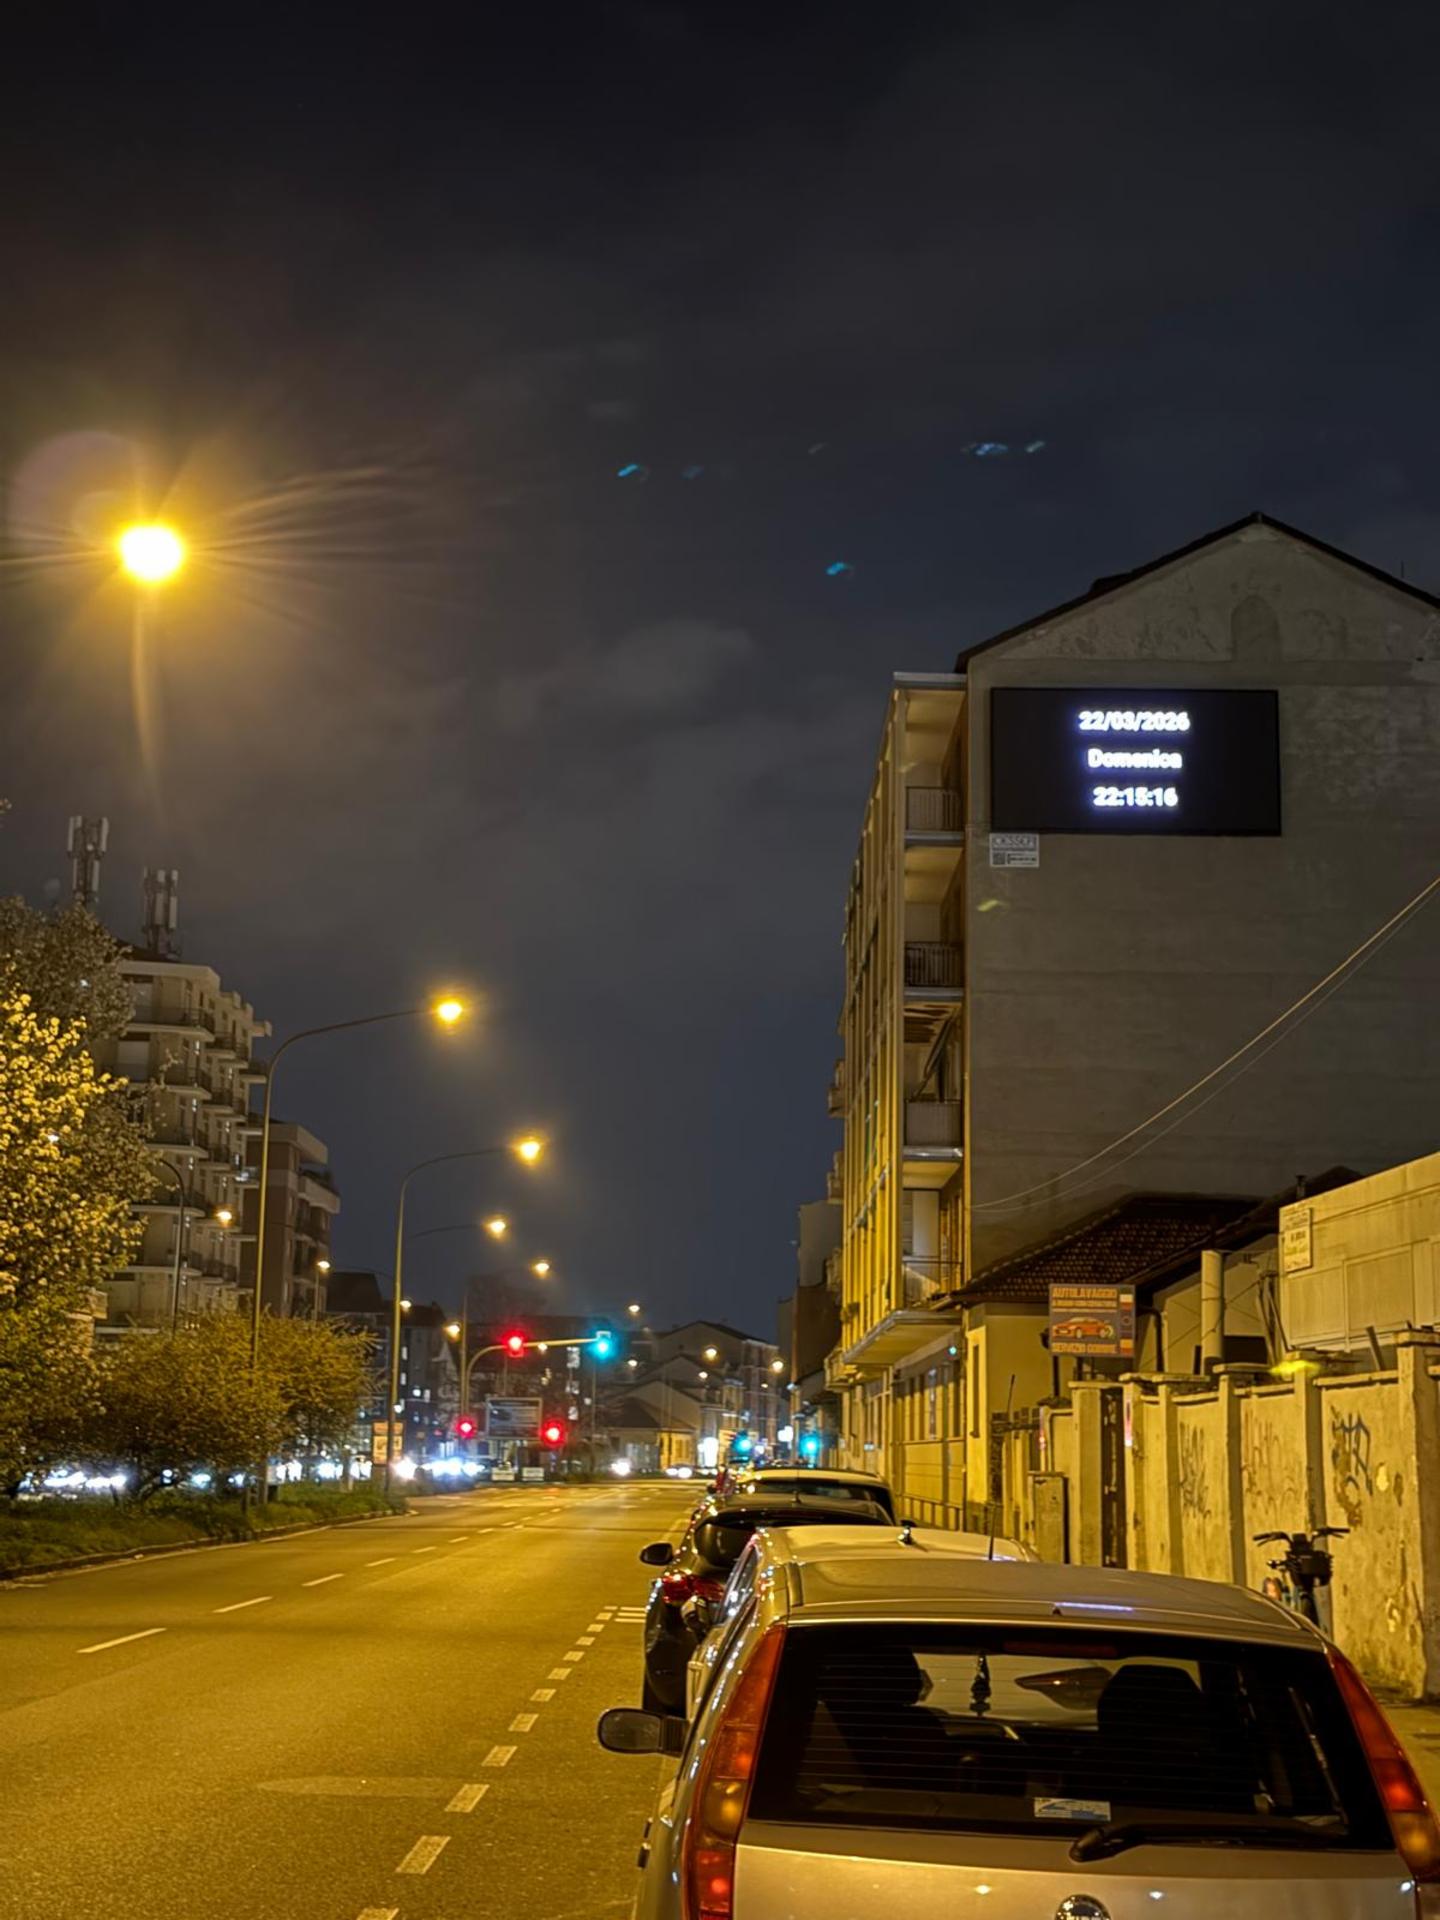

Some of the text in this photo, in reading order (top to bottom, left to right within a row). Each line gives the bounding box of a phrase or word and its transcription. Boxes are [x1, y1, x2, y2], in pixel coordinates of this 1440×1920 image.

[1078, 710, 1191, 732] 22/03/2026
[1087, 747, 1183, 769] Domenica
[1092, 786, 1179, 807] 22:15:16
